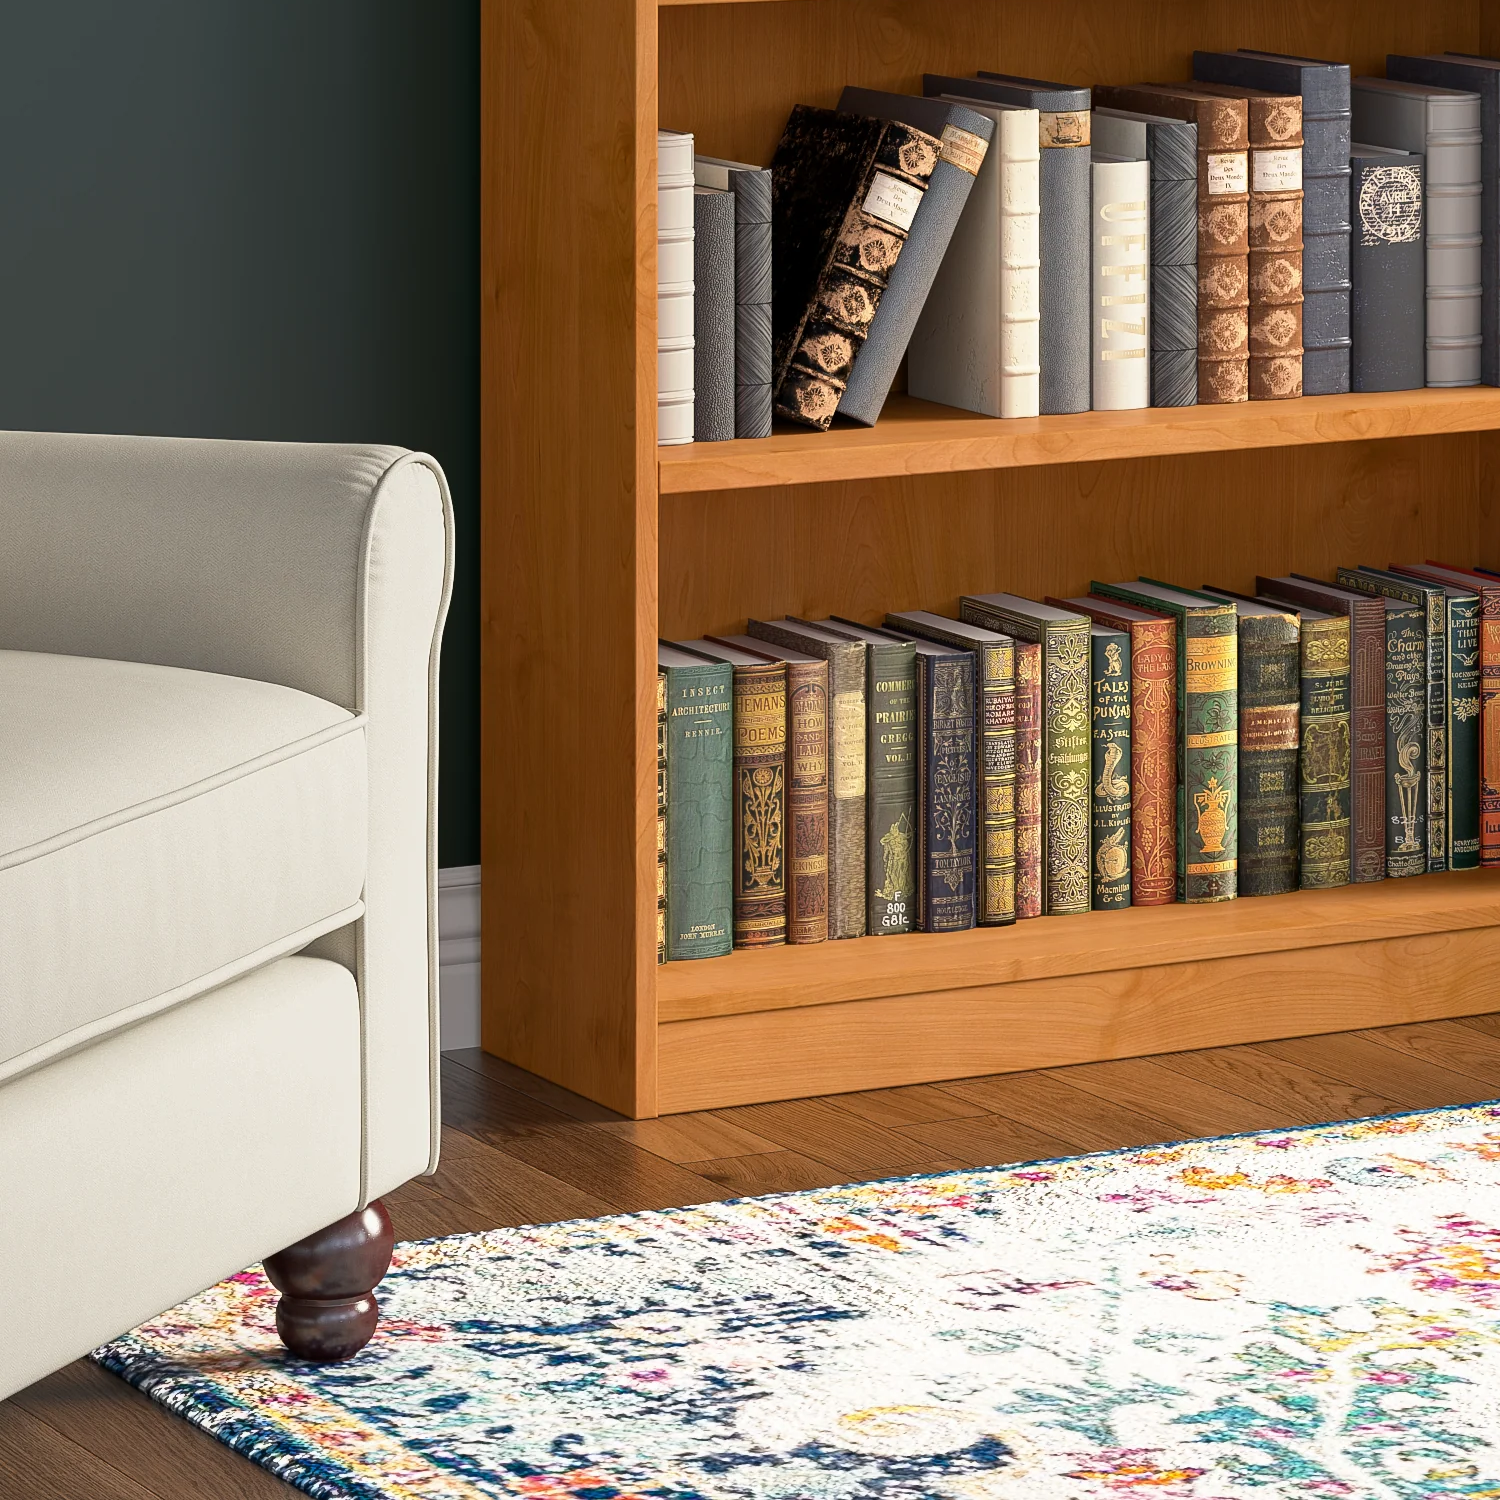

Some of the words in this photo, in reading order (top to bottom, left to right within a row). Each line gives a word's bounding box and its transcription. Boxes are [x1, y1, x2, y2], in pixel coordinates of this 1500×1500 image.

[1099, 200, 1146, 362] UFFIZI
[1457, 628, 1478, 639] THAT
[1387, 638, 1425, 653] Charm
[1457, 637, 1478, 649] LIVE
[1137, 653, 1163, 664] LADY
[1137, 663, 1156, 673] THE
[1395, 669, 1421, 684] Plays
[1094, 678, 1129, 694] TALES
[1457, 680, 1479, 689] KELLY
[681, 684, 726, 699] INSECT
[734, 694, 786, 714] HEMANS
[797, 716, 824, 730] HOW
[735, 725, 786, 746] POEMS
[802, 732, 822, 742] AND
[798, 743, 824, 757] LADY
[796, 761, 825, 773] WHY
[894, 890, 902, 902] F
[886, 902, 907, 915] 800
[690, 923, 716, 932] LONDON
[679, 932, 697, 941] JOHN
